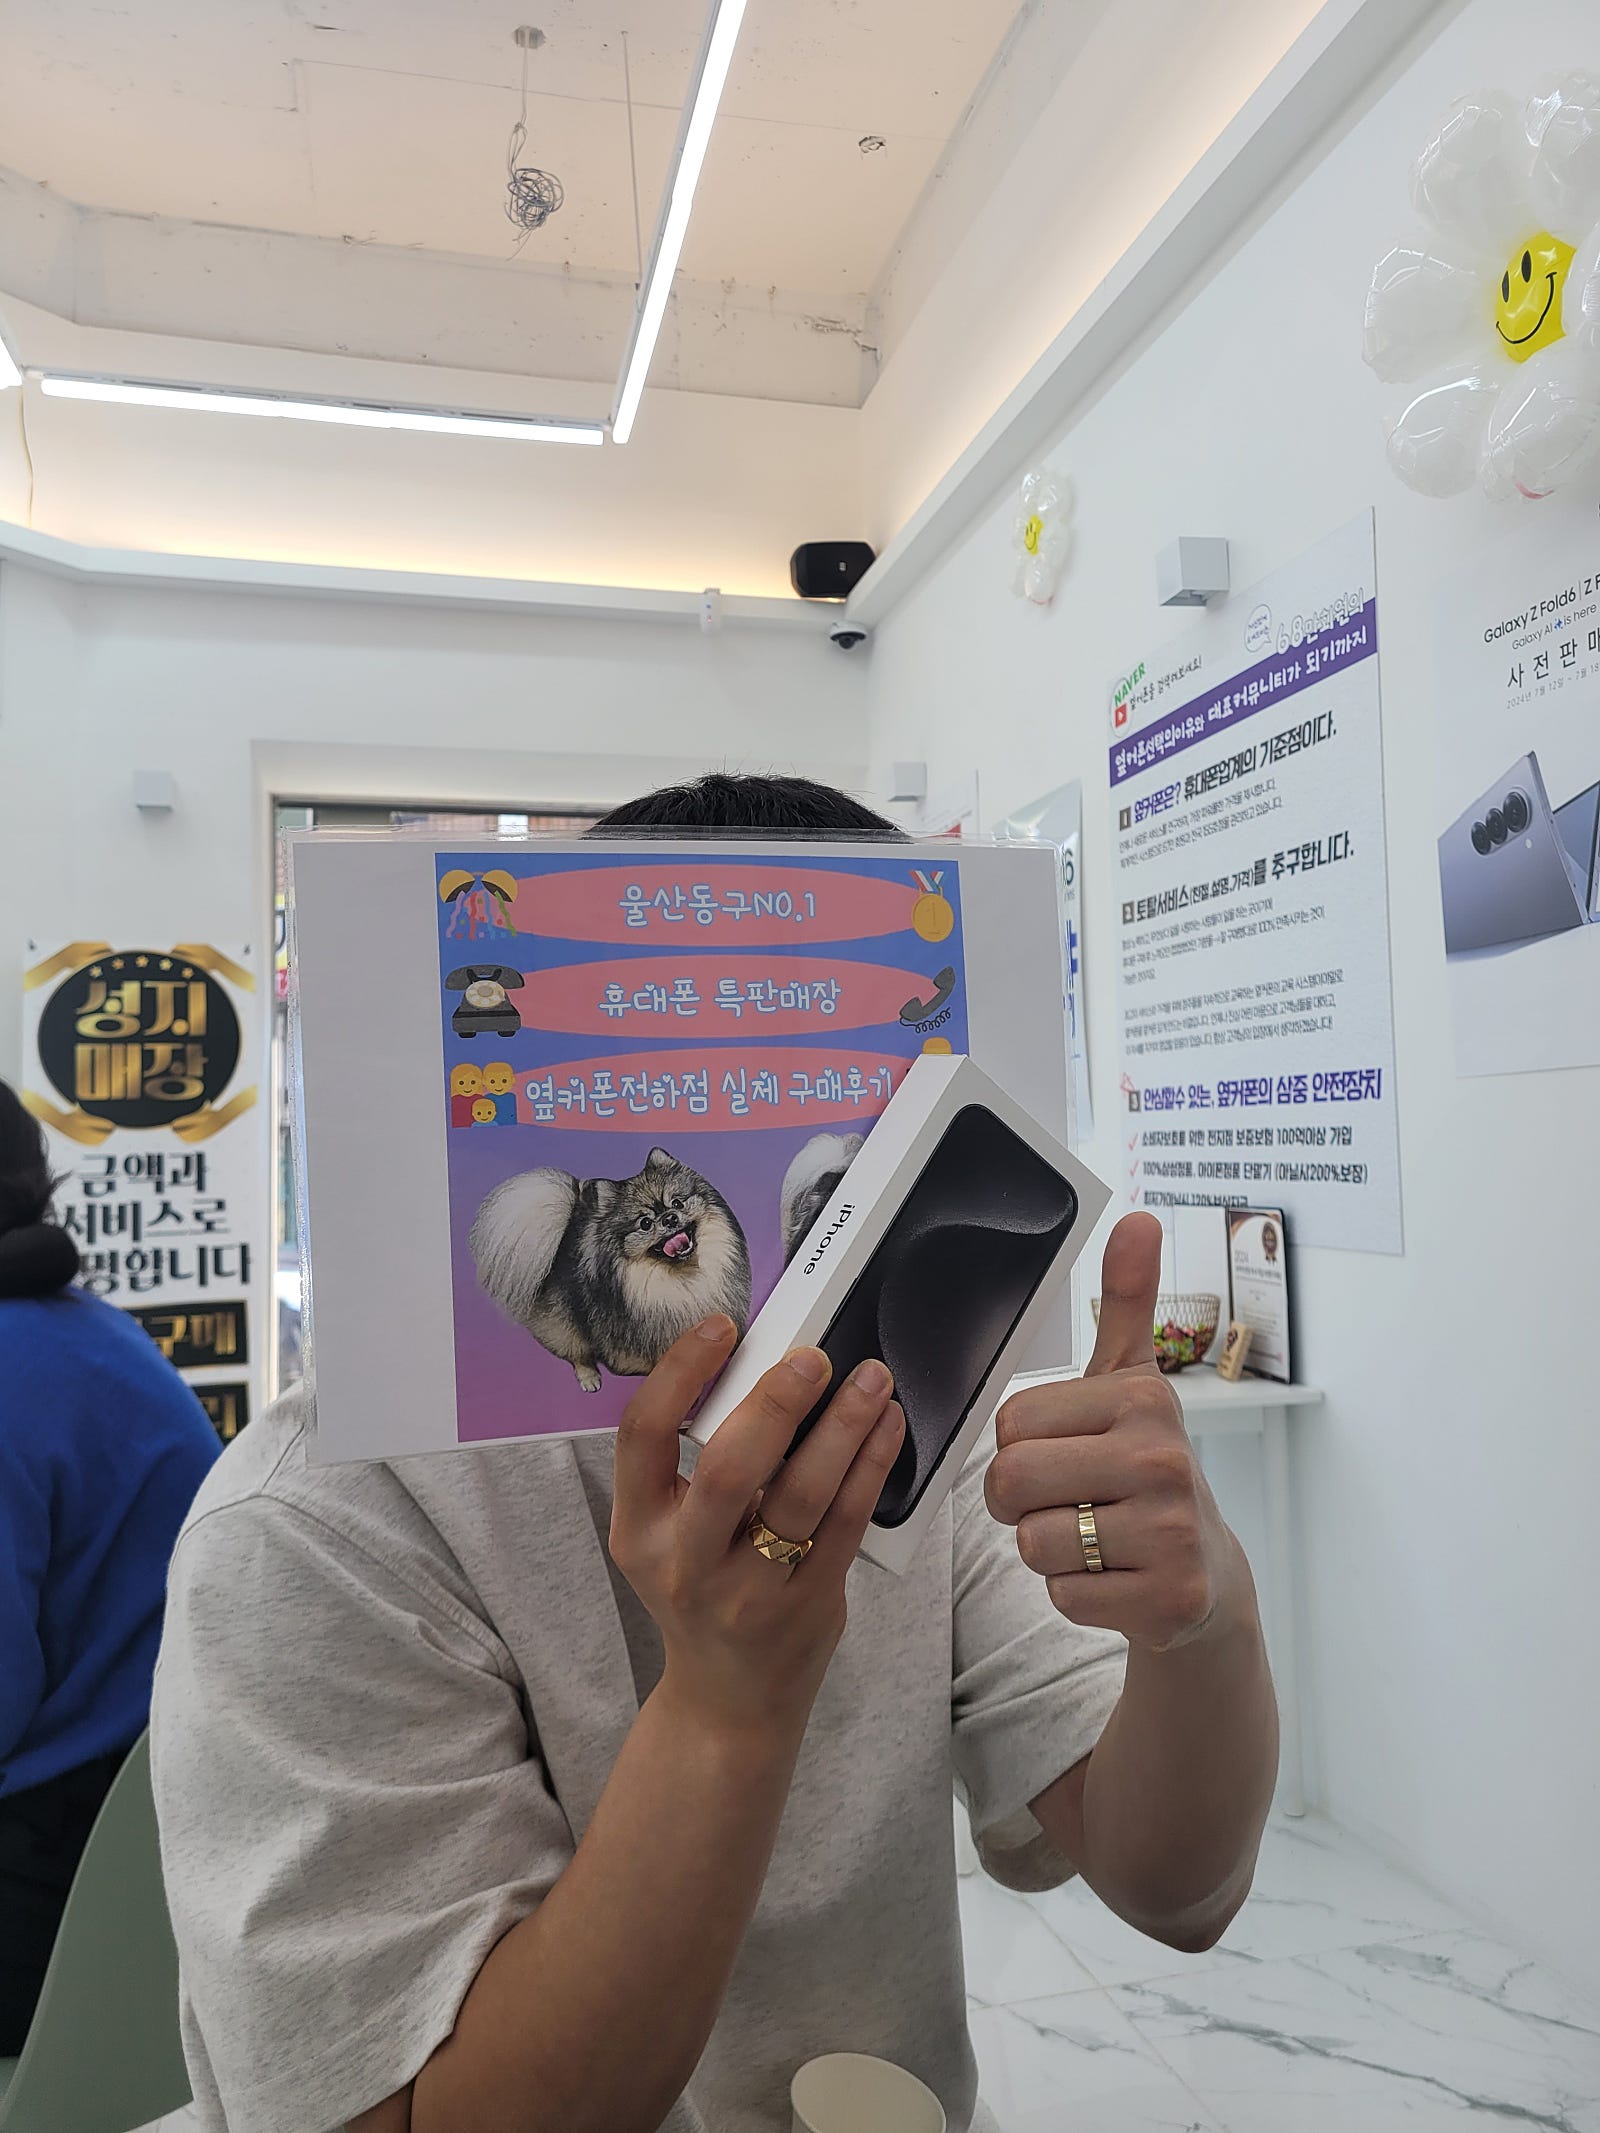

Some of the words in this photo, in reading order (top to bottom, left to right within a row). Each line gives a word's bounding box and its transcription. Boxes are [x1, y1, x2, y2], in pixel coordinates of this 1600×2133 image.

[1484, 612, 1529, 643] Galaxy
[1530, 605, 1538, 621] Z
[1540, 587, 1577, 617] Fold6
[1584, 578, 1592, 595] Z
[1512, 629, 1543, 650] Galaxy
[1544, 623, 1553, 636] AI
[1563, 616, 1572, 626] is
[1574, 603, 1597, 622] here
[1306, 625, 1367, 674] 되기까지
[1114, 662, 1146, 706] NAVER
[1184, 746, 1256, 802] 휴대폰업계의
[1260, 711, 1337, 768] 기준점이다.
[1272, 830, 1354, 880] 추구합니다.
[619, 883, 817, 928] 울산동구NO.1
[75, 980, 208, 1039] 성지
[599, 977, 700, 1018] 휴대폰
[714, 977, 843, 1018] 특판매장
[74, 1041, 209, 1102] 매장
[524, 1069, 710, 1122] 옆커폰전하점
[721, 1068, 781, 1116] 실제
[788, 1064, 894, 1106] 구매후기
[1217, 1077, 1272, 1108] 옆커폰의
[1277, 1075, 1308, 1104] 삼중
[1312, 1068, 1382, 1102] 안전장치
[1330, 1125, 1352, 1145] 가입
[80, 1151, 208, 1197] 금액과
[1243, 1162, 1272, 1181] 단말기
[63, 1200, 229, 1245] 서비스로
[804, 1201, 856, 1276] iPhone
[81, 1242, 251, 1295] 명입니다
[136, 1312, 237, 1358] 구매
